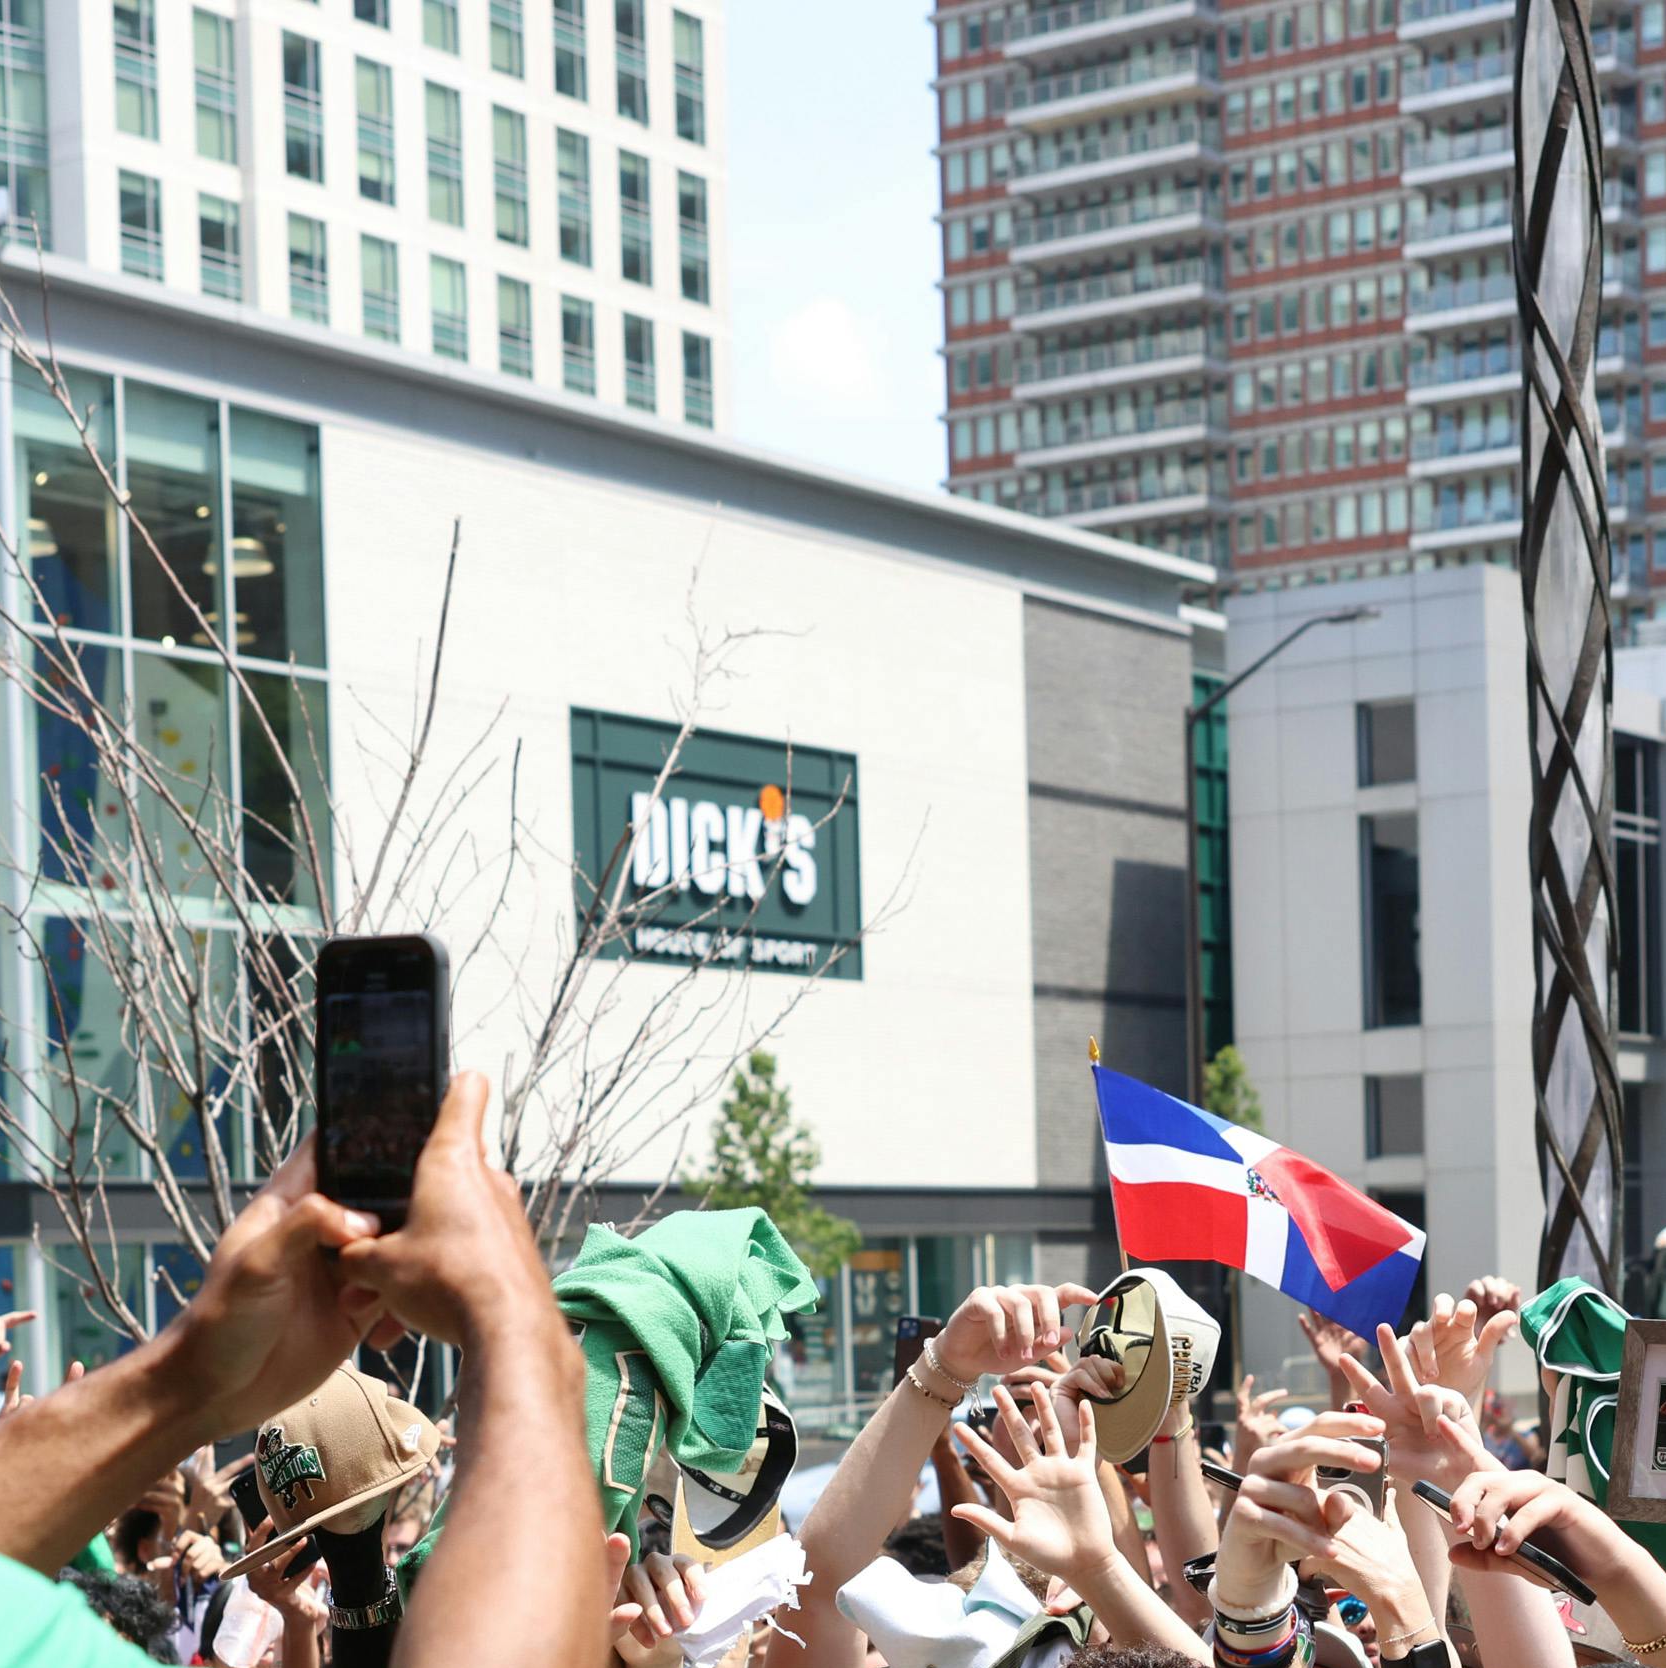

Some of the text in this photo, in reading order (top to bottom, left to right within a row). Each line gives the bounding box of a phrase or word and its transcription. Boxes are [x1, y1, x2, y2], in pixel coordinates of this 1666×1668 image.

[631, 791, 818, 905] DICK'S
[635, 926, 711, 959] HOUSE
[751, 938, 818, 966] SPORT
[1187, 1361, 1203, 1395] NBA
[275, 1450, 319, 1489] CELTICS
